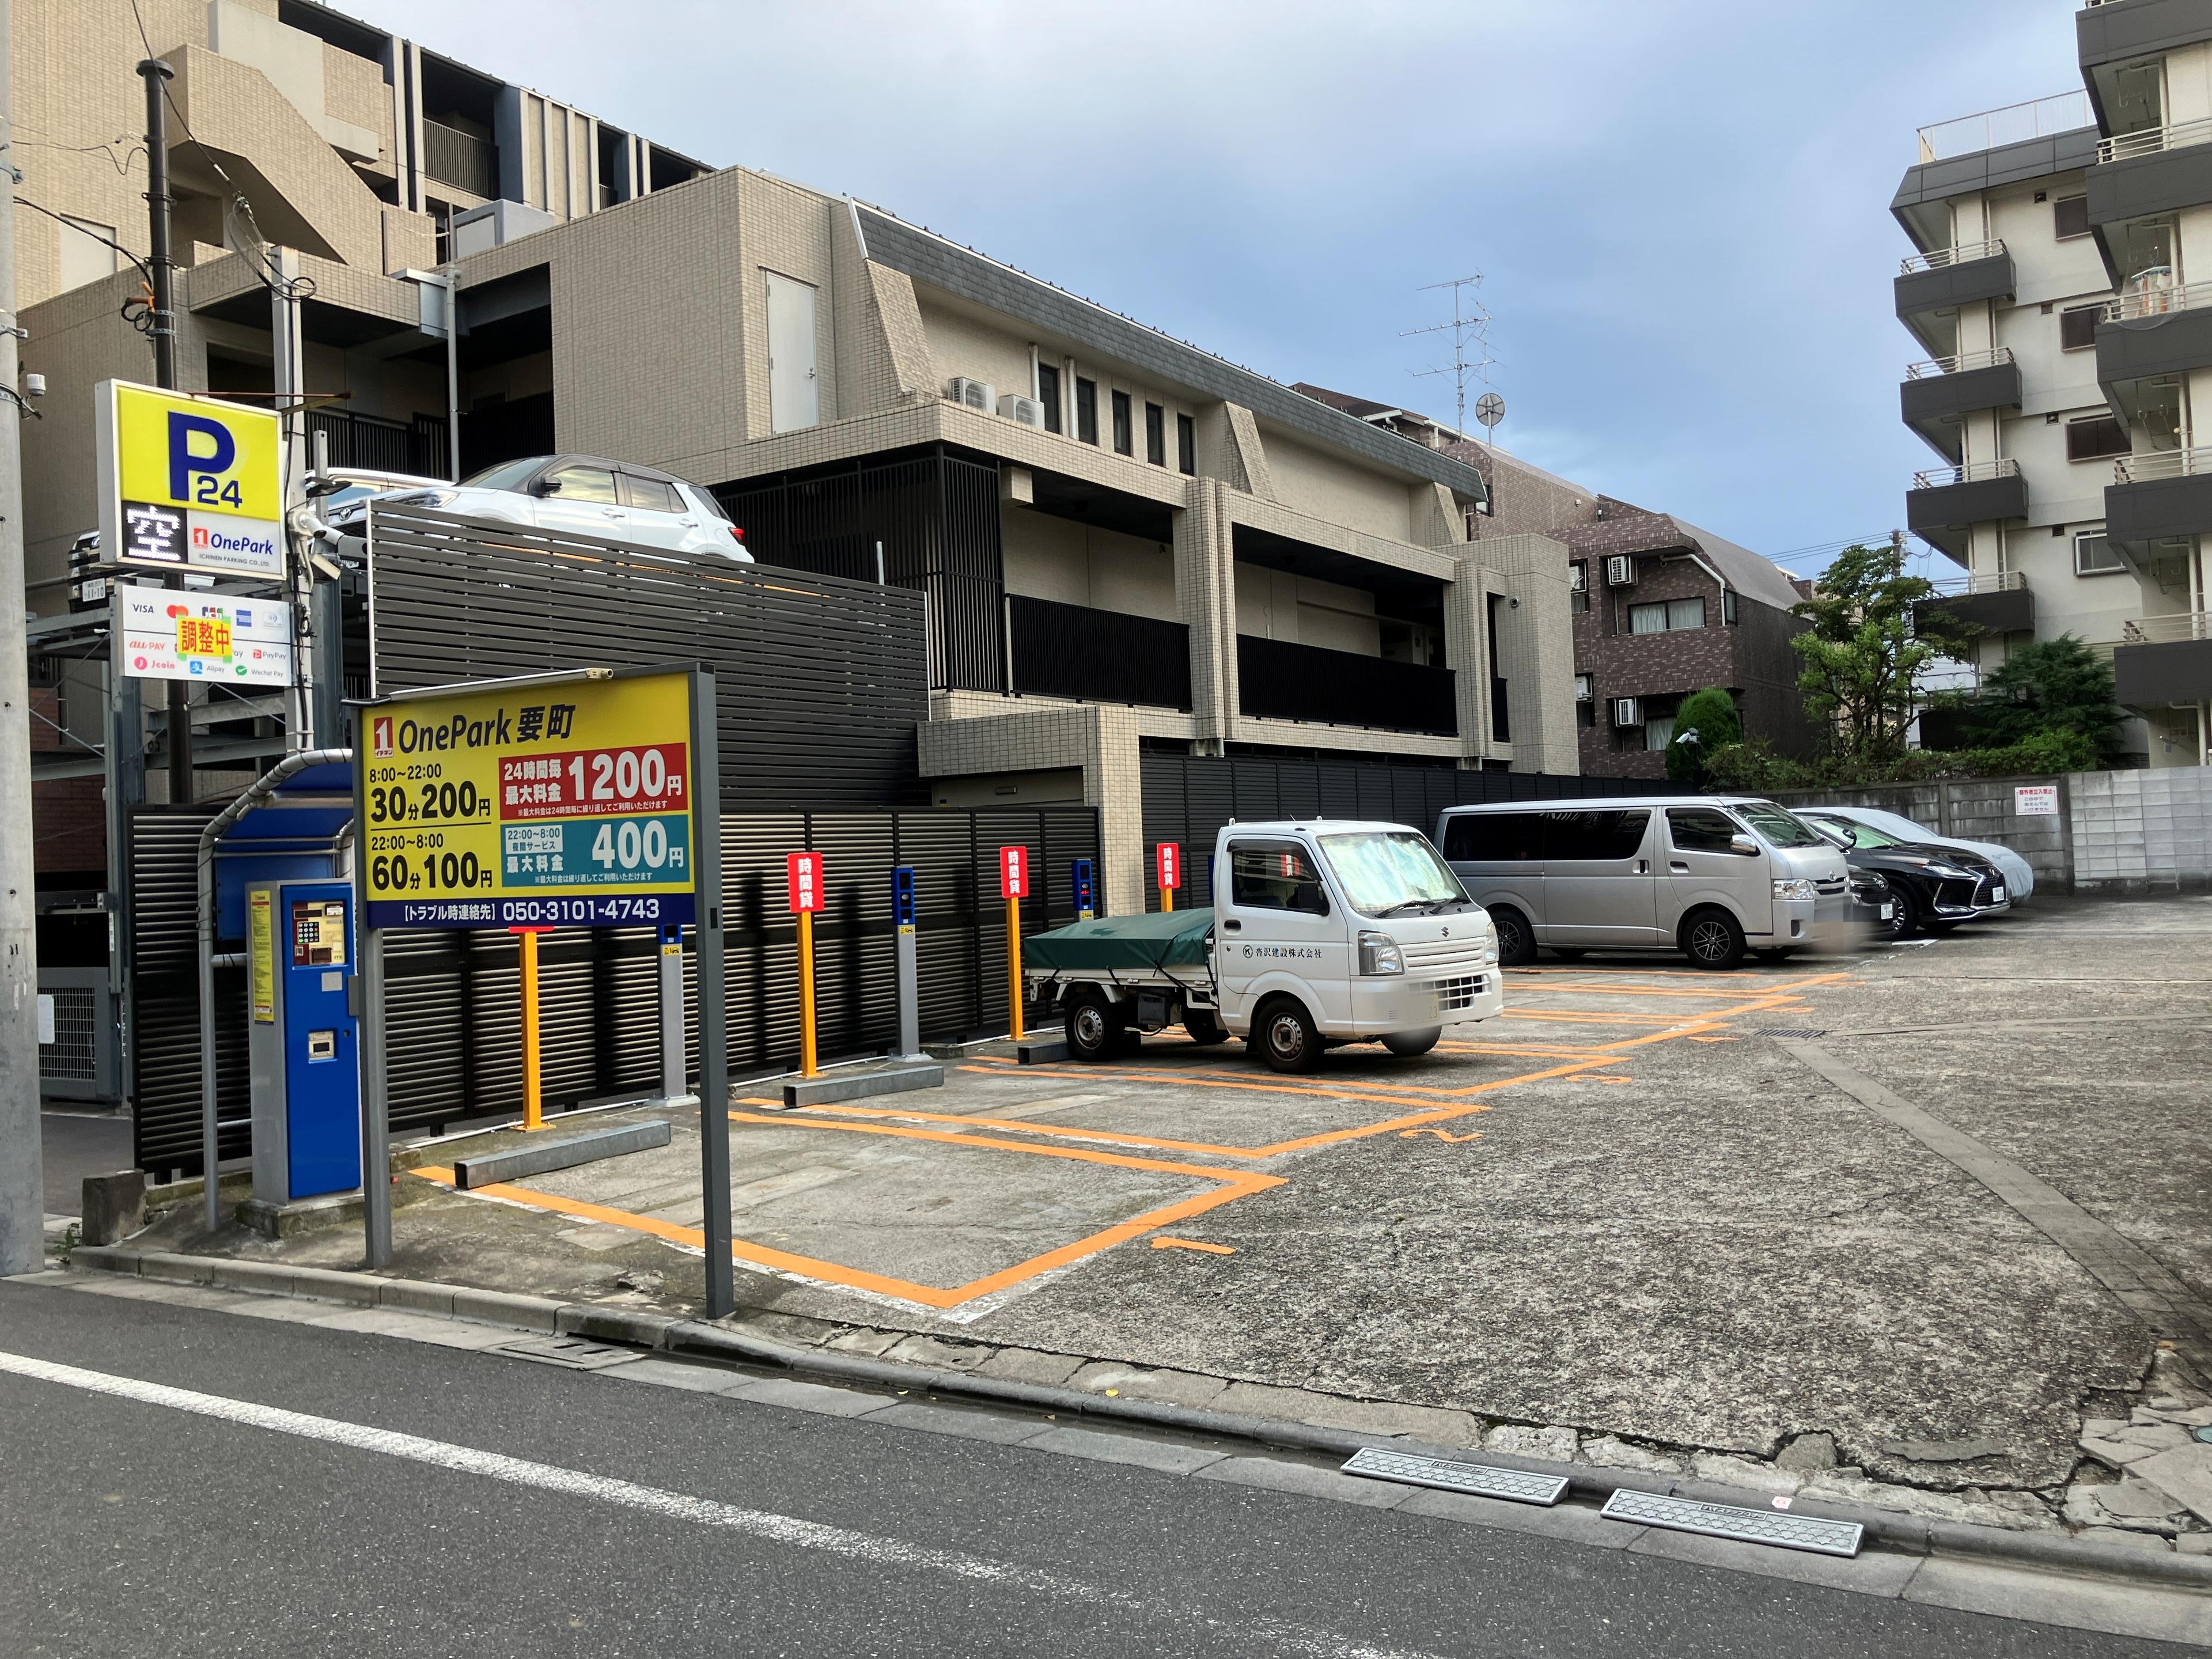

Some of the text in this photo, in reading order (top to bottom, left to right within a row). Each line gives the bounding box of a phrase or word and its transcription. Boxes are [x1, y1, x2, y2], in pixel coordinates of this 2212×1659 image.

[168, 411, 243, 508] P 24
[127, 505, 181, 561] 空
[211, 533, 274, 555] OnePark
[132, 604, 154, 613] VISA
[181, 620, 229, 654] 調整中
[232, 650, 244, 658] ay
[263, 652, 286, 660] PayPay
[399, 708, 512, 753] OnePark
[517, 704, 576, 743] 要町
[504, 759, 561, 781] 24時間毎
[568, 749, 682, 800] 1200円
[505, 783, 562, 805] 最大料金
[512, 841, 556, 852] 夜間サービス
[592, 820, 684, 869] 400円
[507, 854, 563, 873] 最大料金
[1008, 850, 1020, 894] 時間貸
[1163, 847, 1173, 885] 時間貸
[798, 857, 813, 908] 時間貸
[502, 899, 660, 921] 050-3101-4743
